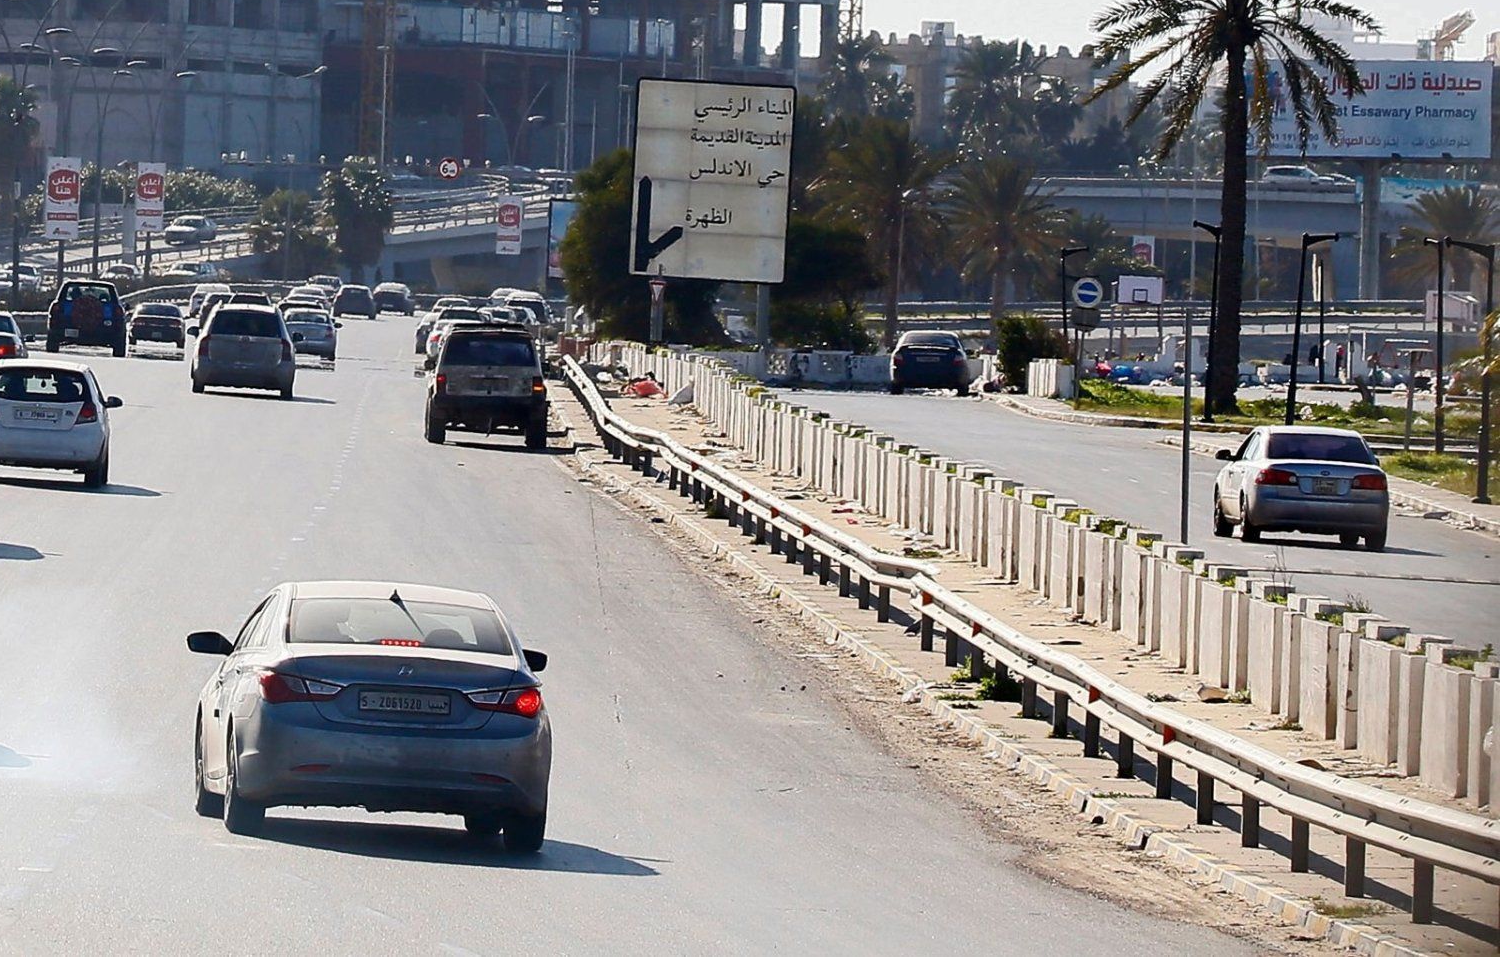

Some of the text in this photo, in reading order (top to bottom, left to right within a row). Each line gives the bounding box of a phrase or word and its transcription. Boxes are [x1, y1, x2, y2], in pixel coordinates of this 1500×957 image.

[1385, 71, 1416, 91] ذات
[1421, 71, 1482, 96] صيدلية
[693, 97, 792, 123] الميناء الرئيسي
[1351, 105, 1412, 120] Essawary
[1415, 105, 1477, 121] Pharmacy
[690, 127, 786, 149] المدينة القديمة
[442, 163, 448, 173] 6
[689, 158, 785, 188] حي الاندلس
[685, 206, 732, 228] الظهرة
